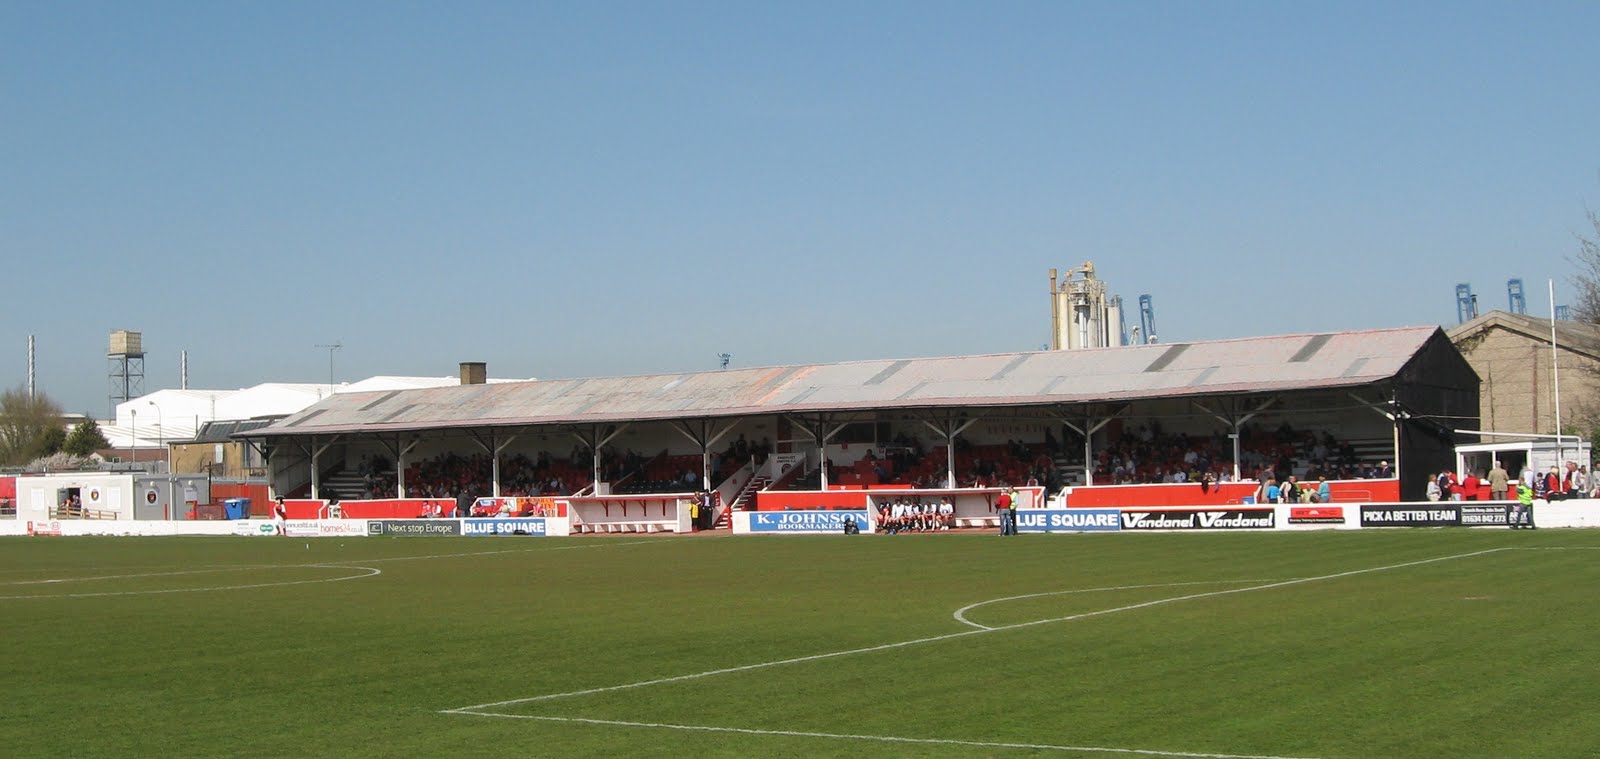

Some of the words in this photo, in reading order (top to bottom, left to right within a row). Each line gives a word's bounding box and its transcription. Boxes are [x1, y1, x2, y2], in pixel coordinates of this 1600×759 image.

[757, 514, 774, 524] K.
[780, 512, 868, 524] JOHNSON
[1014, 514, 1048, 526] LUE
[1051, 513, 1118, 527] SQUARE
[1121, 512, 1194, 528] Vandanel
[1198, 511, 1273, 528] Vandanel
[1363, 511, 1384, 522] PICK
[1384, 511, 1391, 522] A
[1390, 510, 1428, 521] BETTER
[1428, 510, 1456, 521] TEAM
[387, 524, 406, 532] Next
[408, 524, 424, 534] stop
[426, 524, 453, 534] Europe
[464, 522, 494, 534] BLUE
[496, 522, 545, 534] SQUARE
